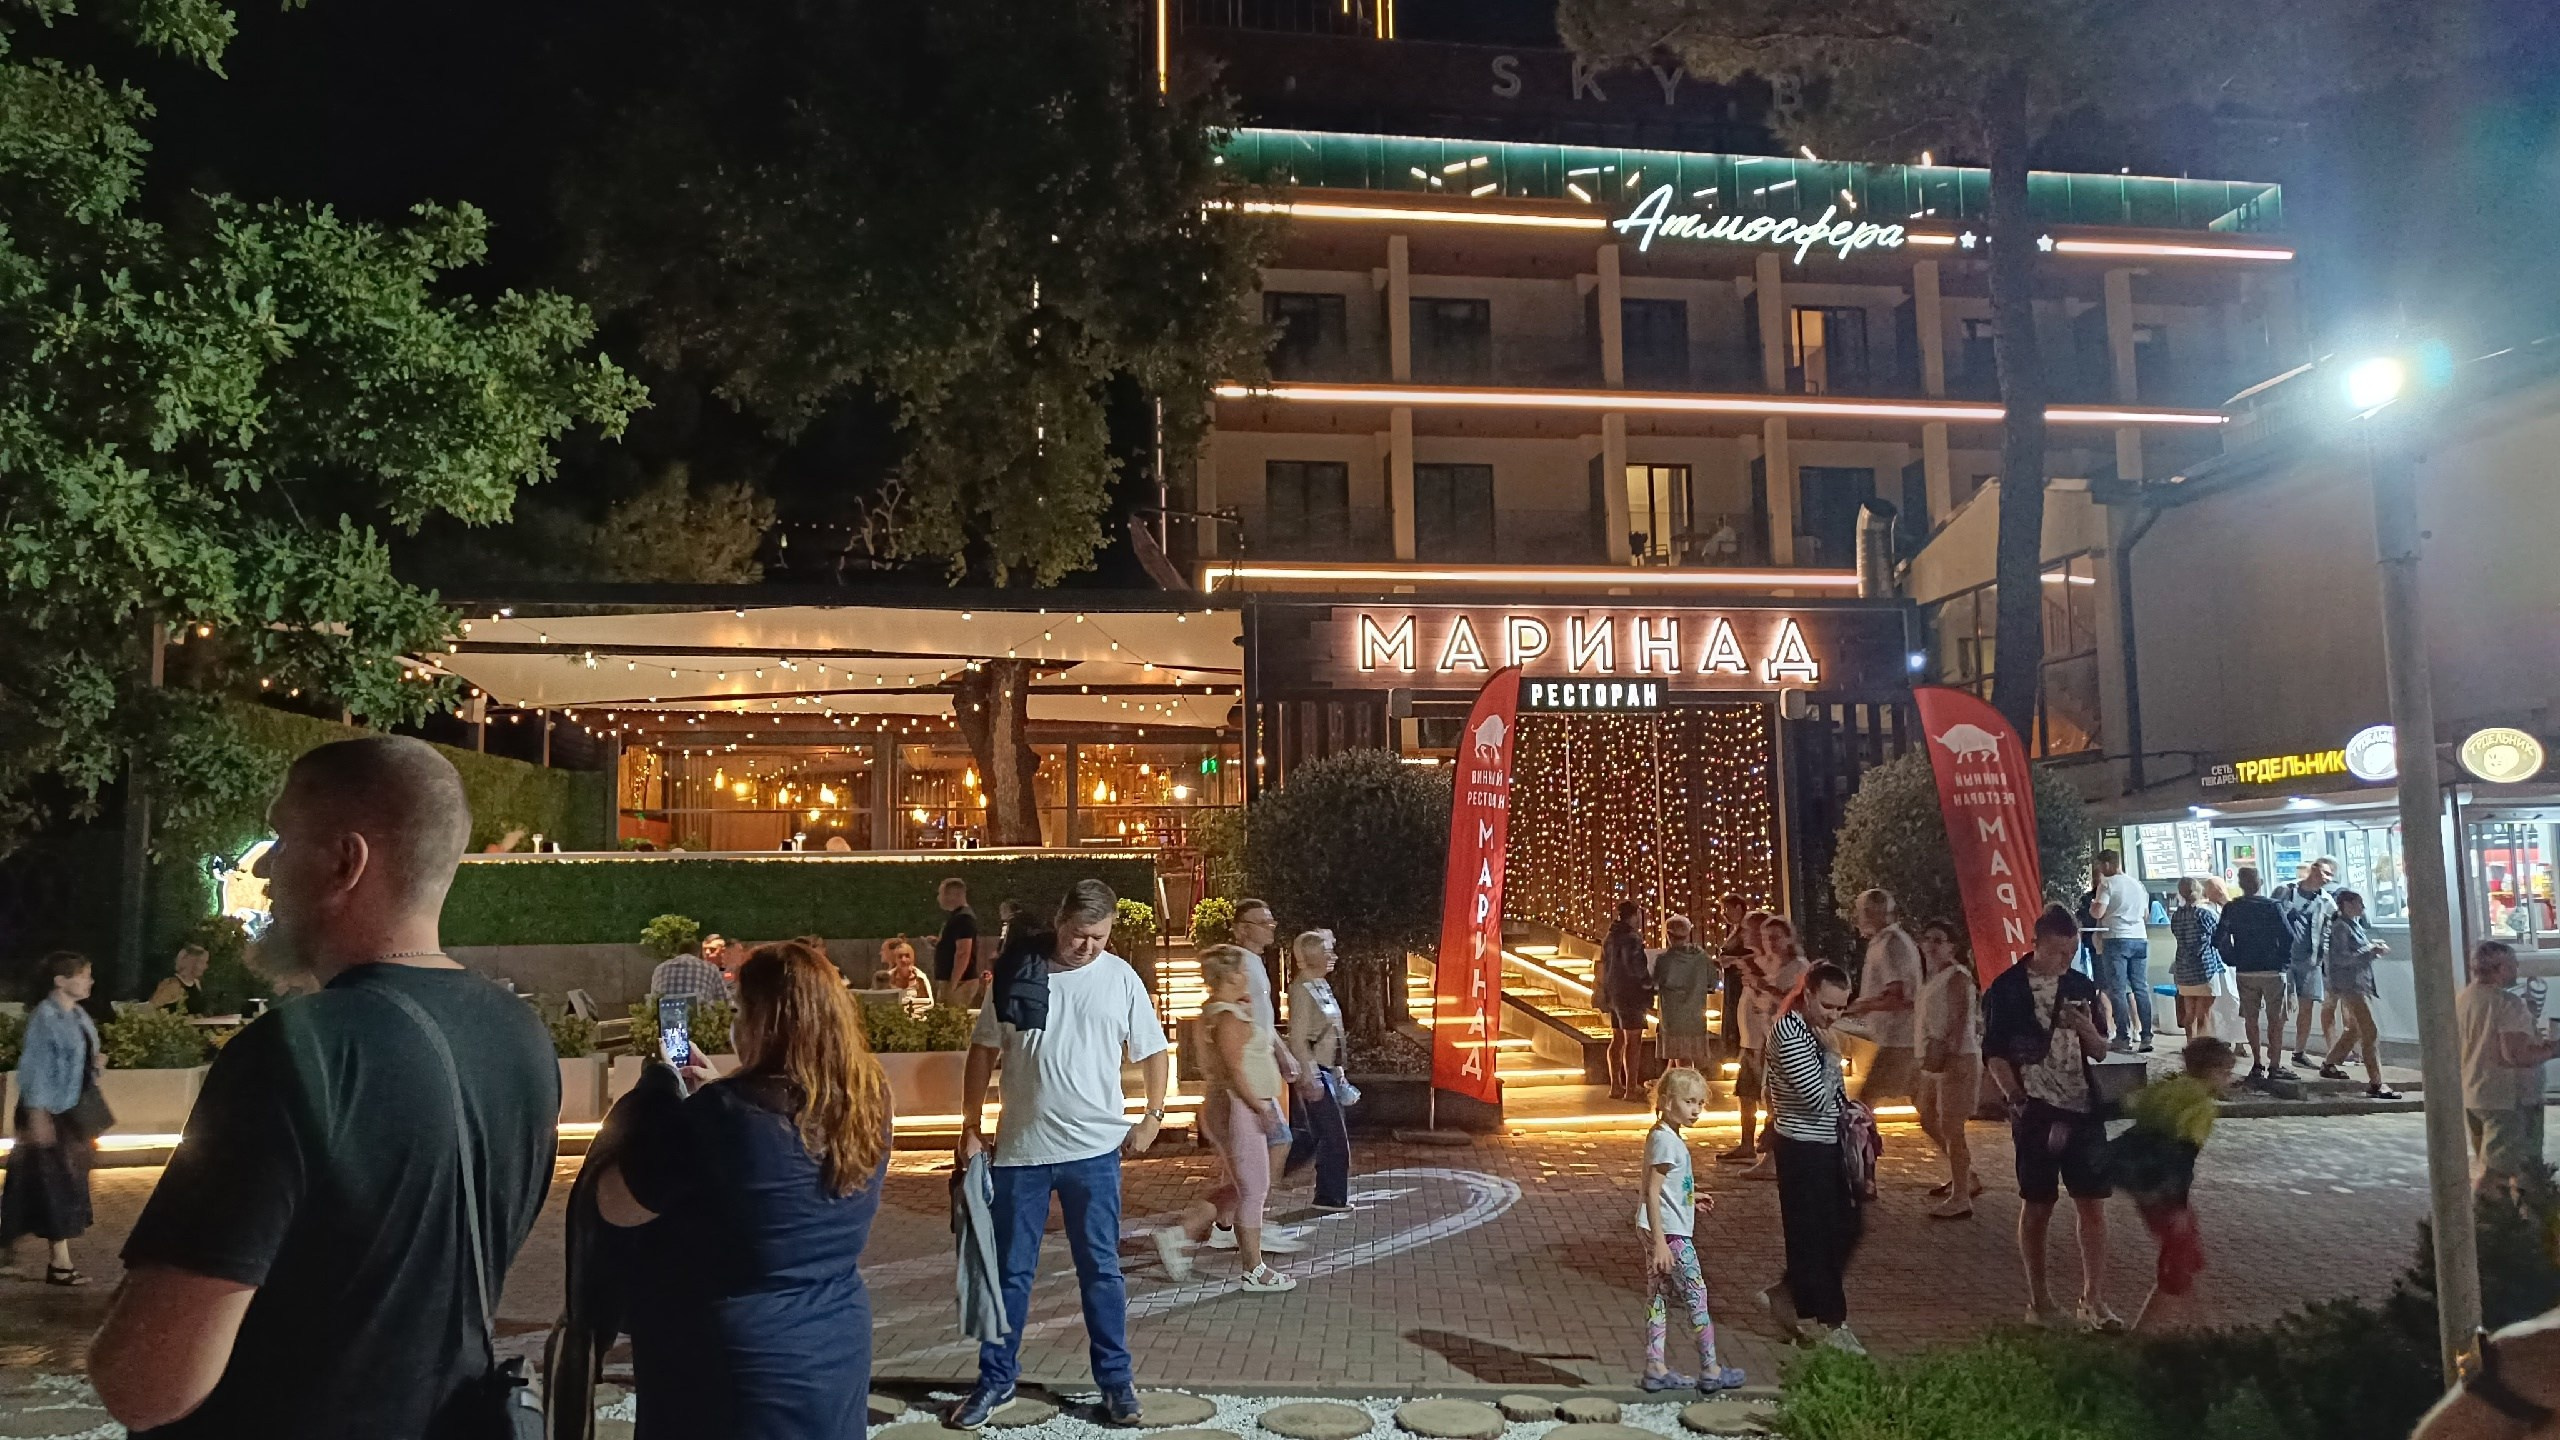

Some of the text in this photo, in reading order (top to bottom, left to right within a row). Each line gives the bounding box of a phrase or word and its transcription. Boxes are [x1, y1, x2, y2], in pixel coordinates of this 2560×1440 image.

[1491, 55, 1684, 105] SKY
[1613, 184, 1905, 264] Атмосфера
[1357, 613, 1821, 684] МАРИНАД
[1531, 683, 1658, 708] РЕСТОРАН
[2468, 733, 2536, 756] ТРДЕЛЬНИК
[2201, 774, 2239, 787] ПЕКАРЕН
[2211, 763, 2233, 776] СЕТЬ
[2236, 749, 2347, 783] ТРДЕЛЬНИК
[1461, 818, 1494, 1081] МАРИНАД
